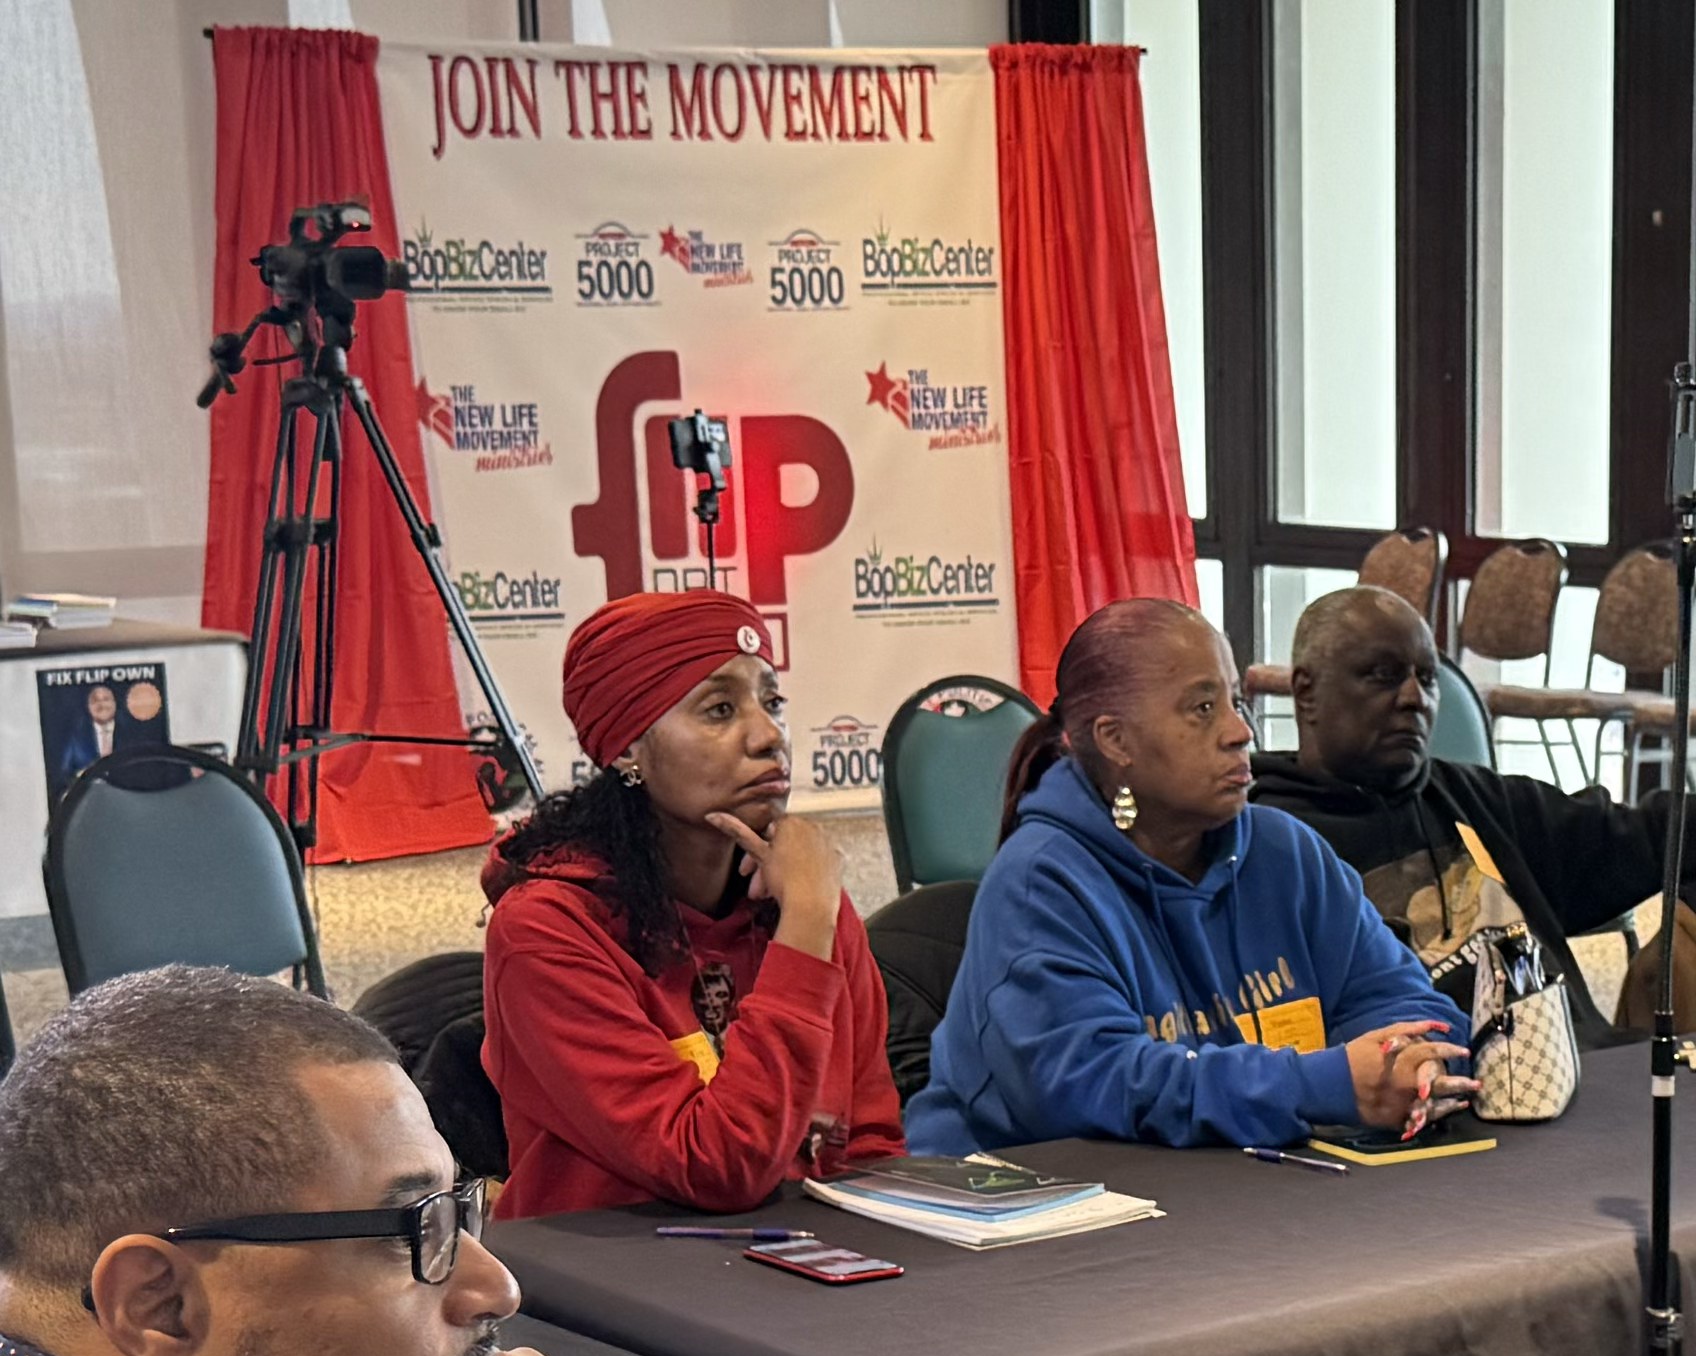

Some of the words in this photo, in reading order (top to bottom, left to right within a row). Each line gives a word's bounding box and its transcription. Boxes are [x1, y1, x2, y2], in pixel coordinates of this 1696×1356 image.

[428, 54, 542, 160] JOIN
[554, 60, 653, 141] THE
[666, 62, 938, 143] MOVEMENT
[403, 238, 548, 289] BopBizCenter
[585, 242, 640, 257] PROJECT
[777, 248, 832, 264] PROJECT
[862, 237, 994, 288] BopBizCenter
[577, 260, 655, 300] 5000
[770, 266, 845, 306] 5000
[451, 385, 475, 402] THE
[910, 387, 946, 410] NEW
[953, 386, 988, 409] LIFE
[454, 404, 495, 428] NEW
[501, 403, 539, 428] LIFE
[911, 411, 988, 431] MOVEMENT
[455, 430, 539, 451] MOVEMENT
[453, 570, 561, 611] BizCenter
[855, 554, 996, 607] BopBizCenter
[46, 670, 73, 686] FIX
[75, 668, 110, 684] FLIP
[112, 665, 156, 682] OWN
[812, 748, 881, 786] 5000
